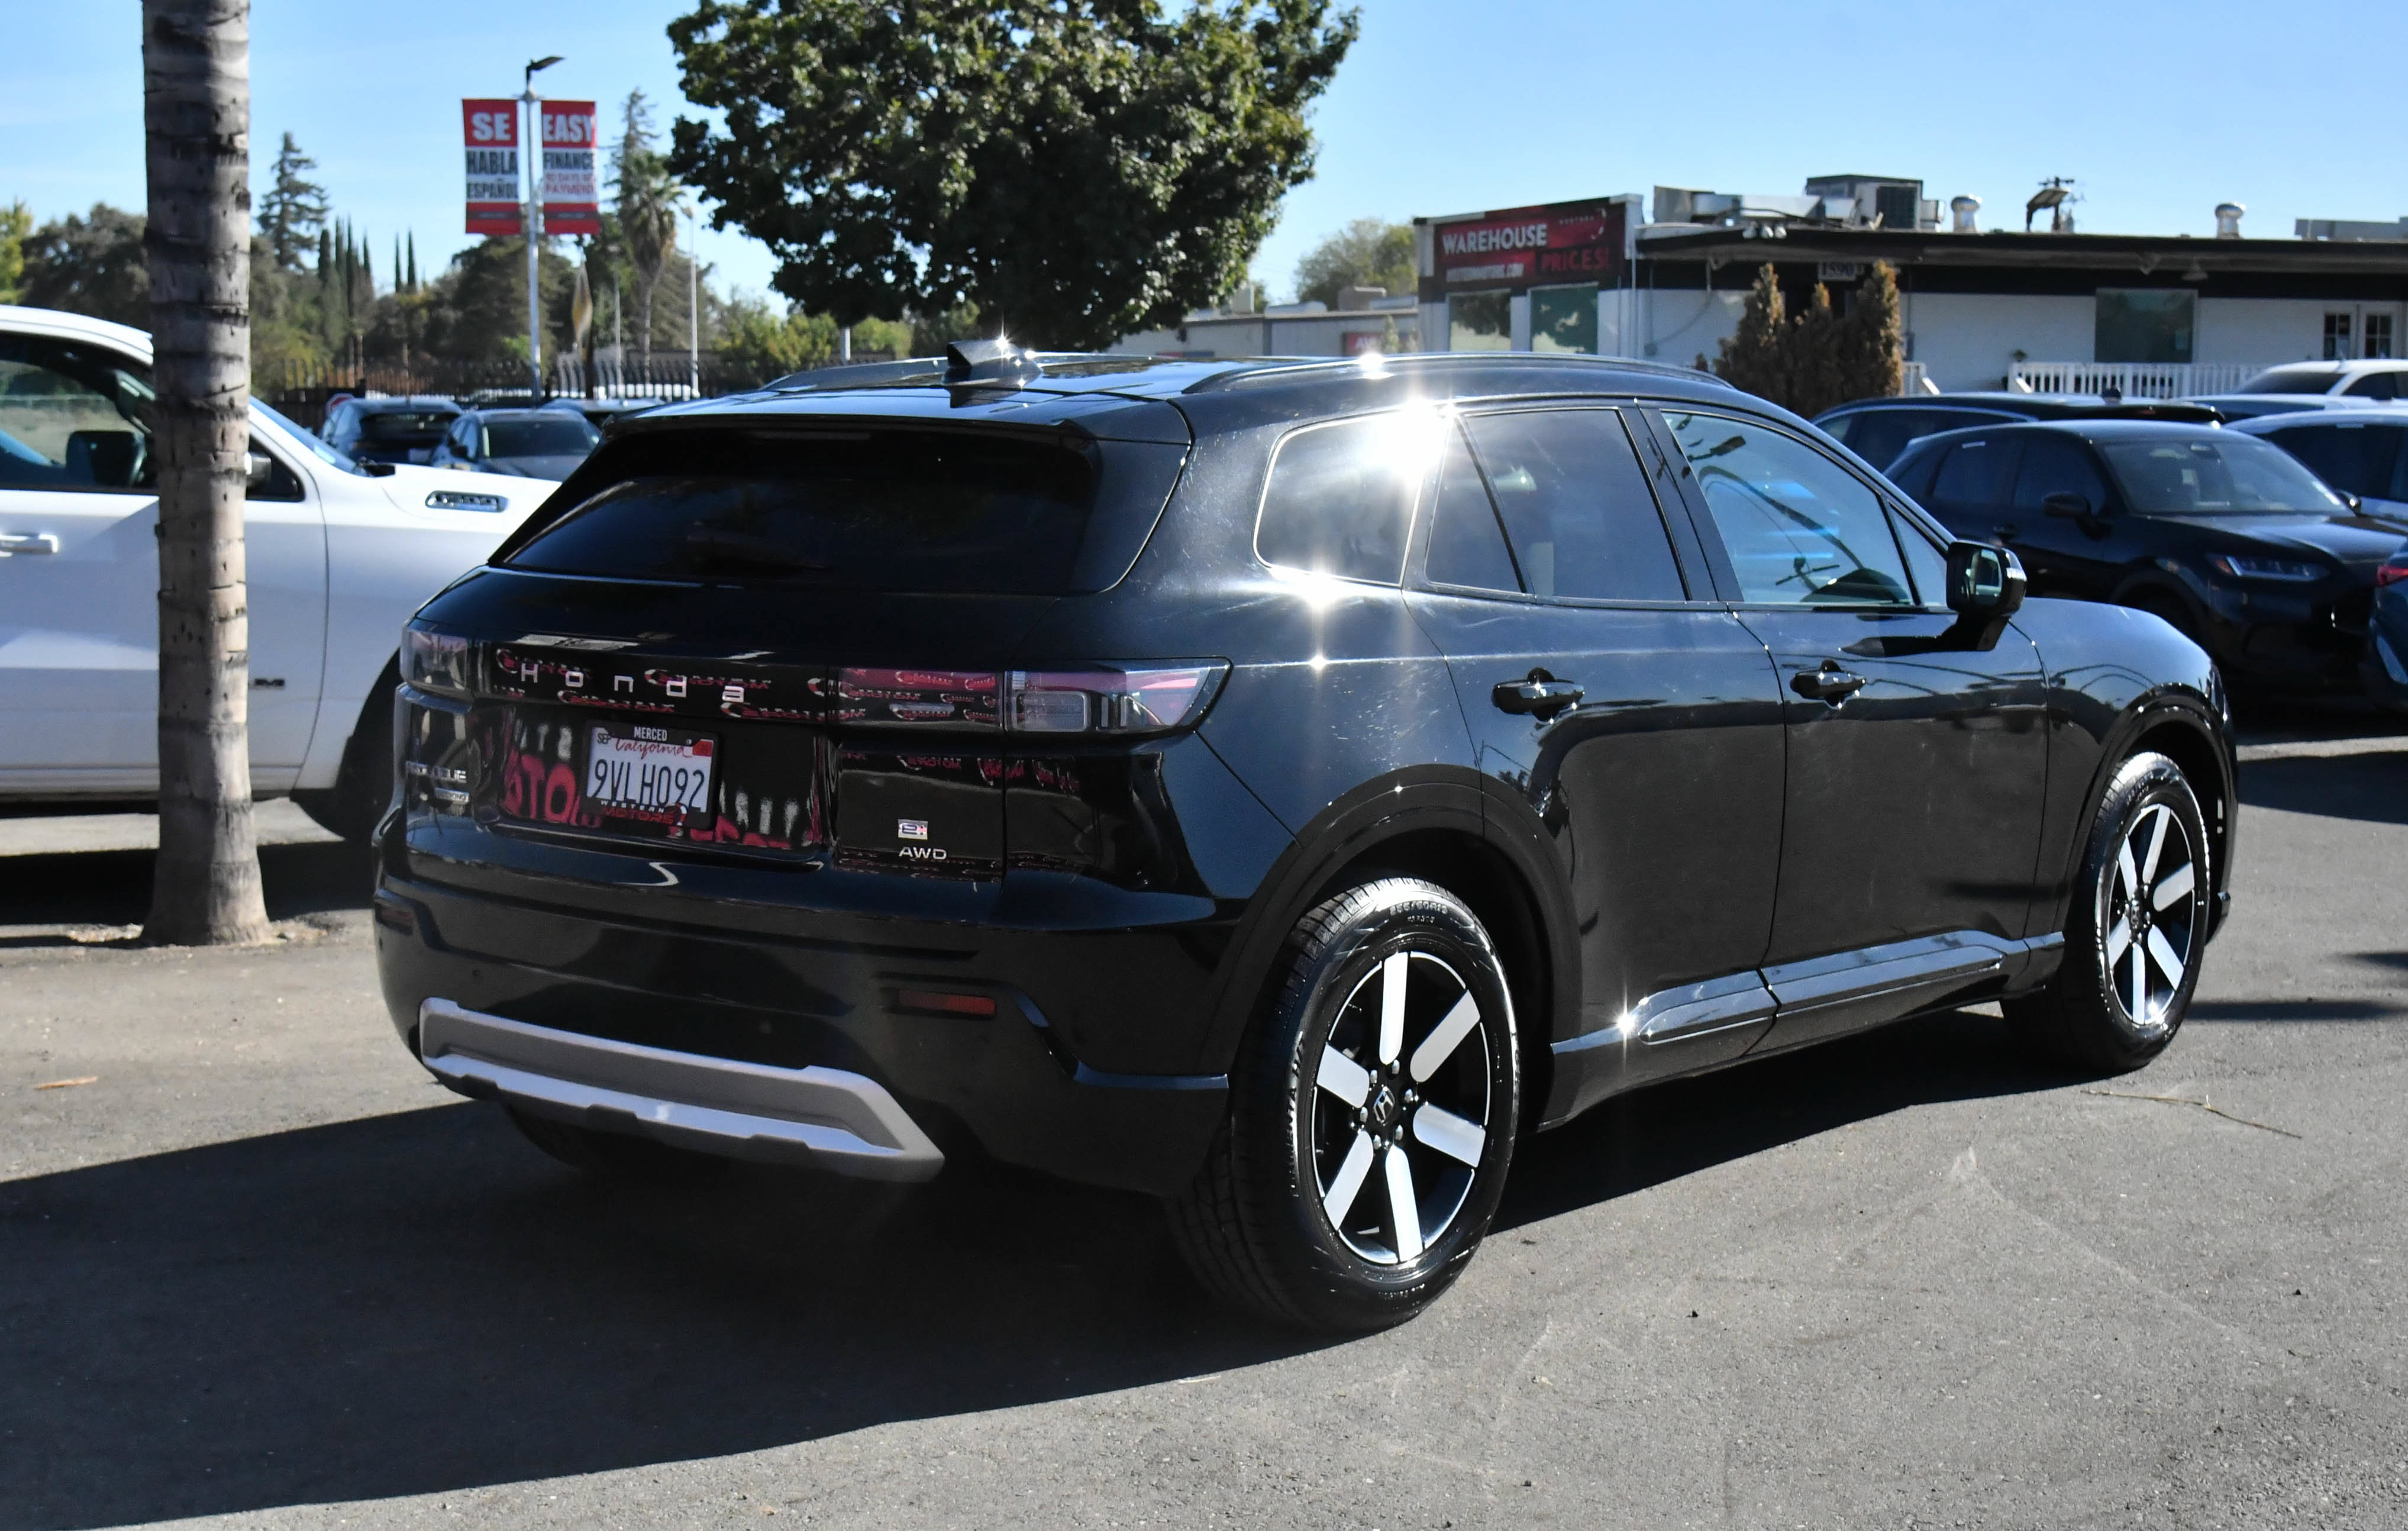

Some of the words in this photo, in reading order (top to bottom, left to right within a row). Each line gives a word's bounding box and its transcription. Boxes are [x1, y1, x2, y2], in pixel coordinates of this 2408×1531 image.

[472, 112, 511, 141] SE
[543, 114, 594, 142] EASY
[467, 151, 518, 175] HABLA
[1442, 222, 1548, 255] WAREHOUSE
[634, 726, 668, 741] MERCED
[615, 738, 693, 760] California
[592, 758, 705, 809] 9VLH092
[602, 806, 674, 824] MOTORS
[899, 846, 947, 860] AWD
